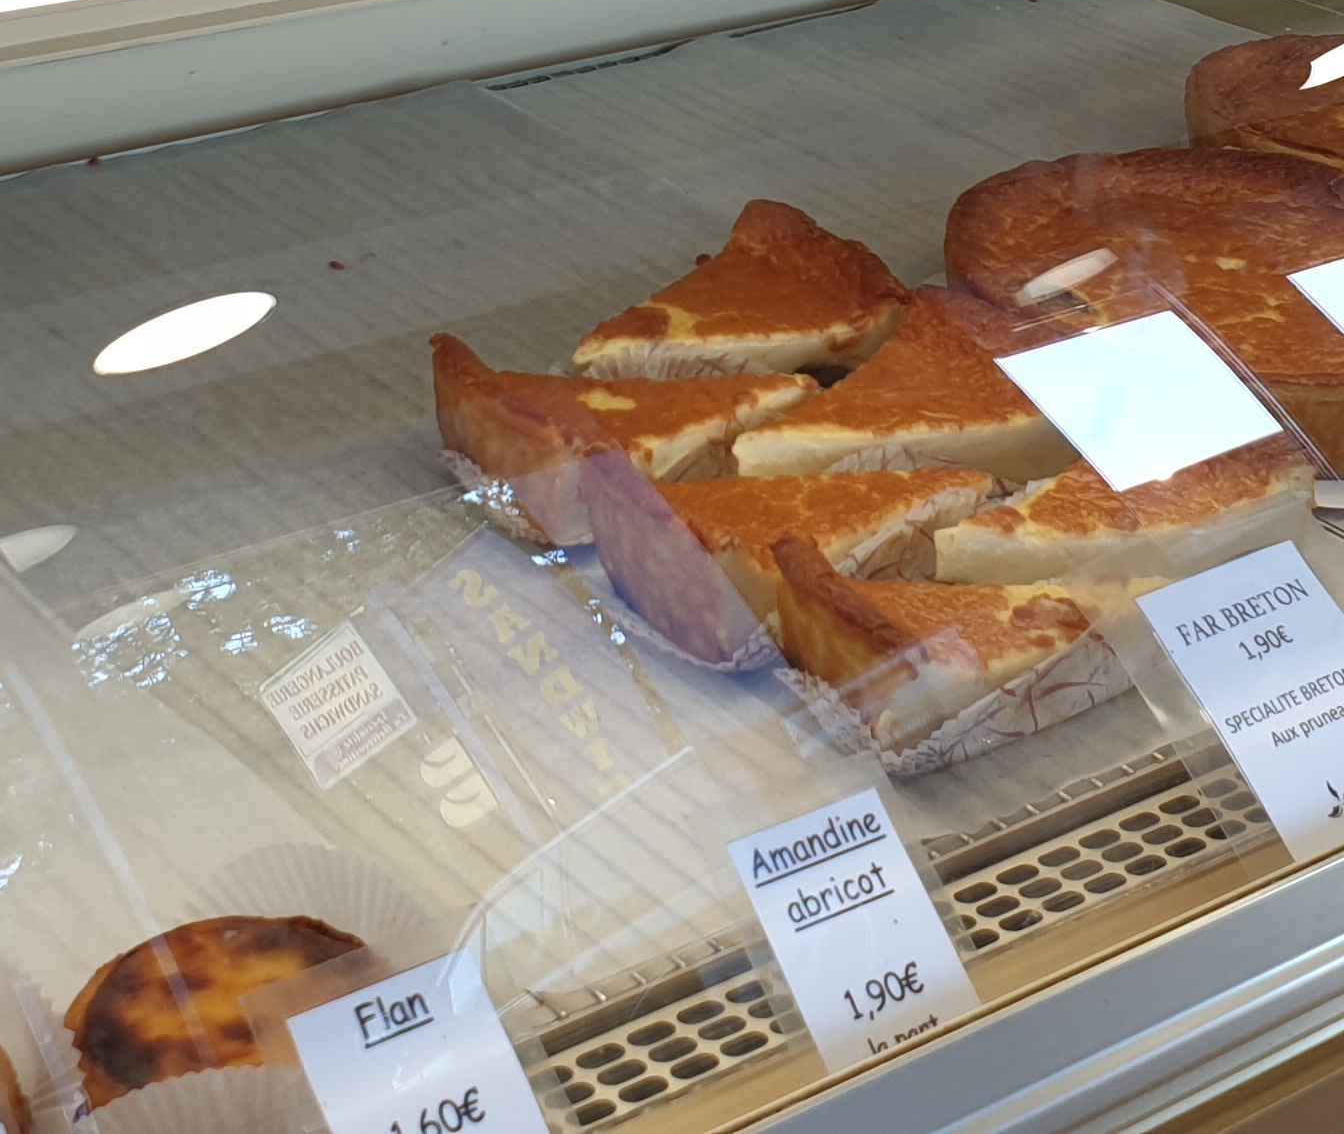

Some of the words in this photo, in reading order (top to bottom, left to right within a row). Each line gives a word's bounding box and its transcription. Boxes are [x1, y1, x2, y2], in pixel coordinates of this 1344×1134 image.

[1175, 614, 1225, 647] FAR
[1219, 578, 1309, 629] BRETON
[1238, 624, 1294, 660] 1,90€
[1225, 689, 1302, 734] SPECIALITE
[1271, 725, 1300, 747] Aux
[753, 813, 882, 879] Amandine
[787, 862, 887, 923] abricot
[354, 993, 430, 1039] Flan
[844, 960, 925, 1020] 1,90€
